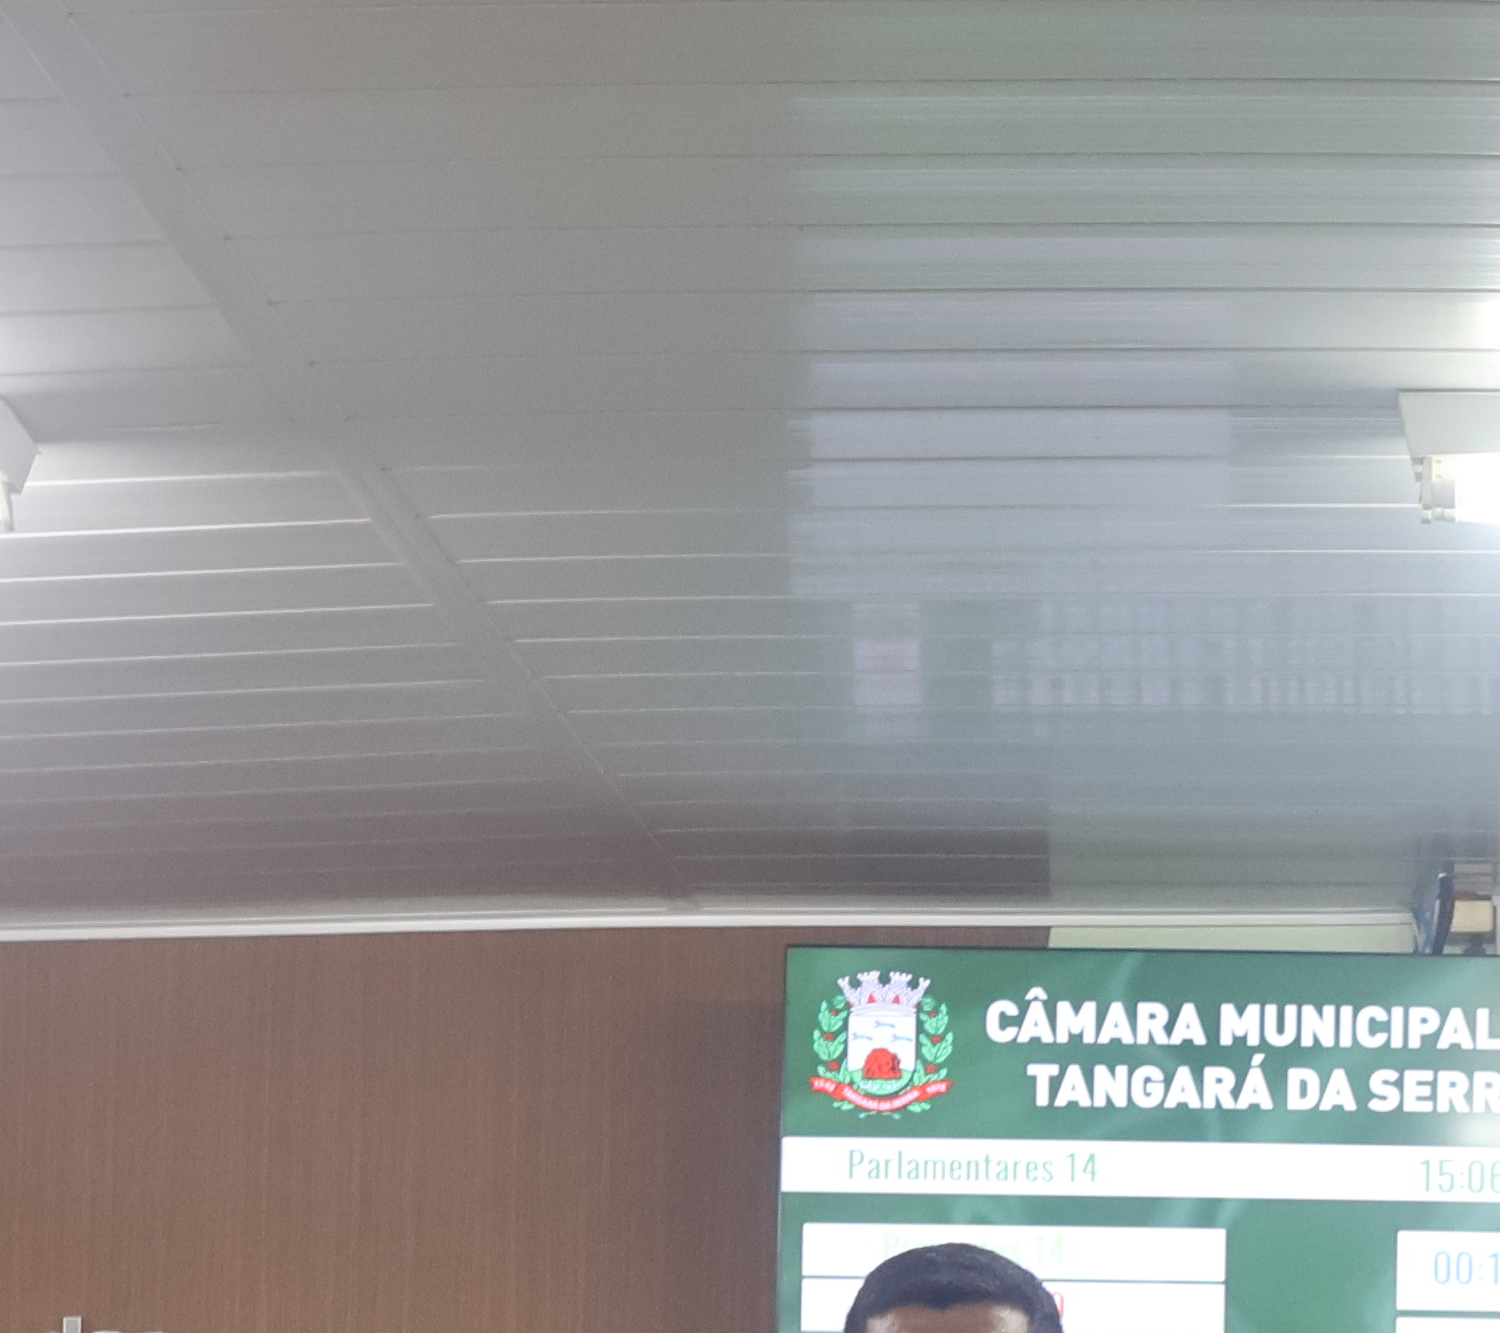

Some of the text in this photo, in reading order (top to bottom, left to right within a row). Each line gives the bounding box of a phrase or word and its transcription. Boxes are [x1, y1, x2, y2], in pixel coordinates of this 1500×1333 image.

[985, 987, 1207, 1046] CÂMARA
[1026, 1054, 1274, 1111] TANGARÁ
[1286, 1068, 1357, 1112] DA
[849, 1149, 1098, 1183] Parlamentares 14
